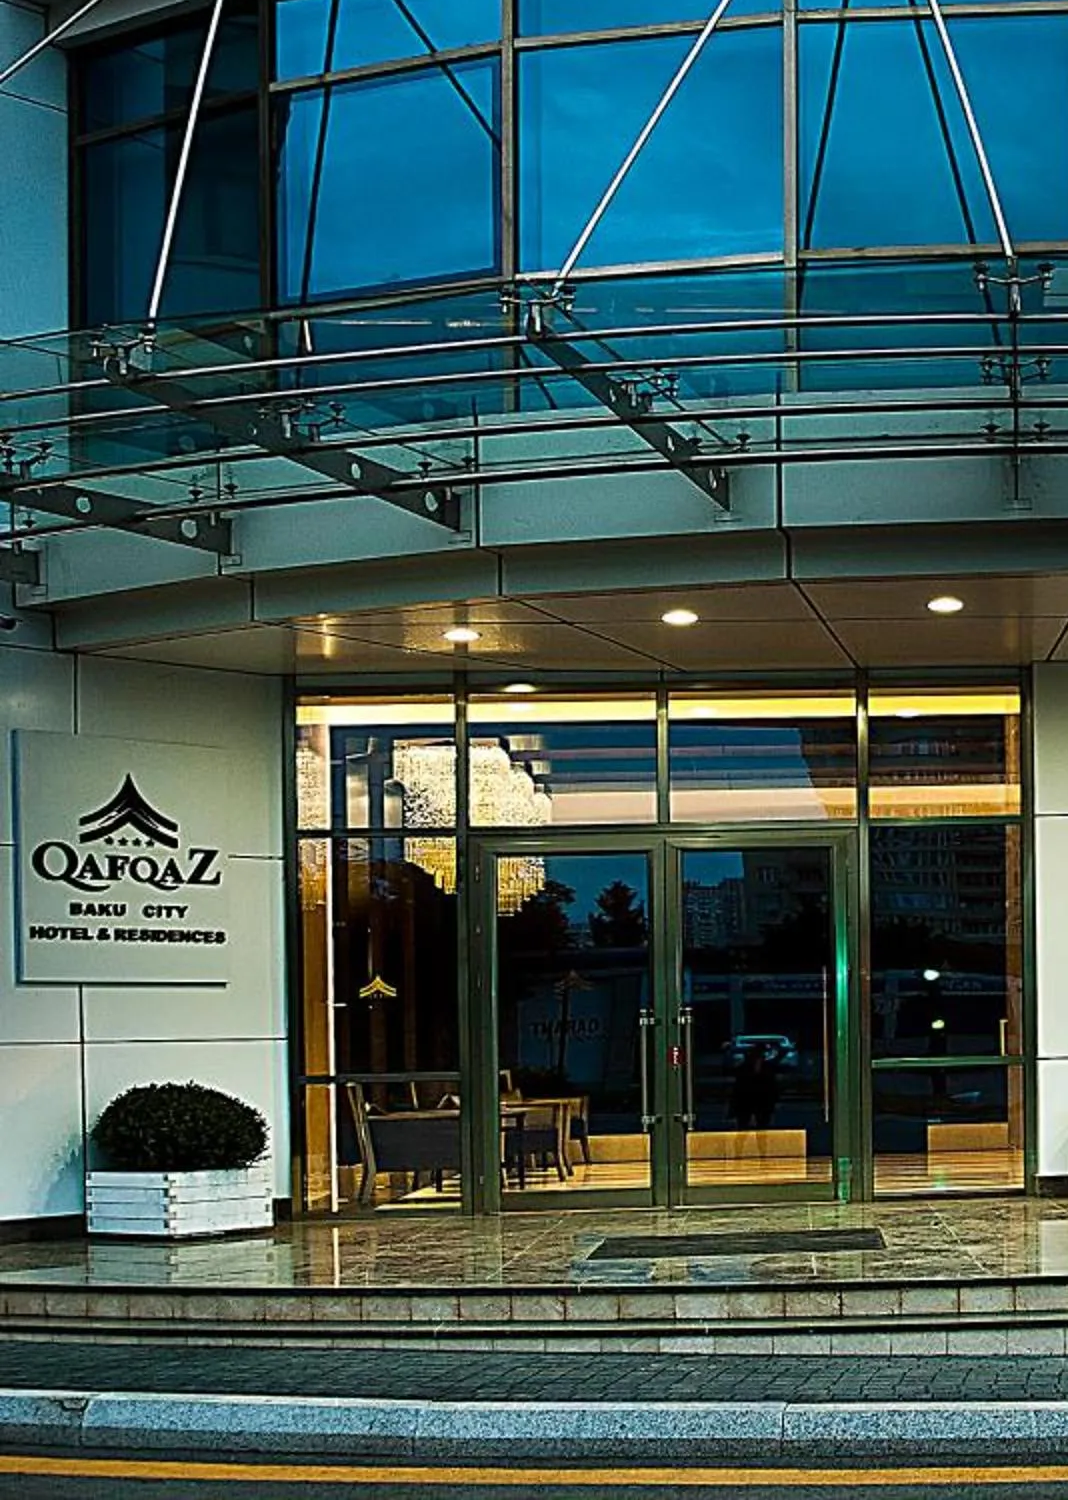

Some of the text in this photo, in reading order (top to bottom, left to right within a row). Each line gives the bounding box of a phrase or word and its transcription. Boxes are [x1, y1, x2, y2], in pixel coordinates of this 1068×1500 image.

[31, 841, 221, 893] QAFQAZ
[69, 902, 189, 919] BAKU CITY
[29, 925, 226, 945] HOTEL & RESIDENCES
